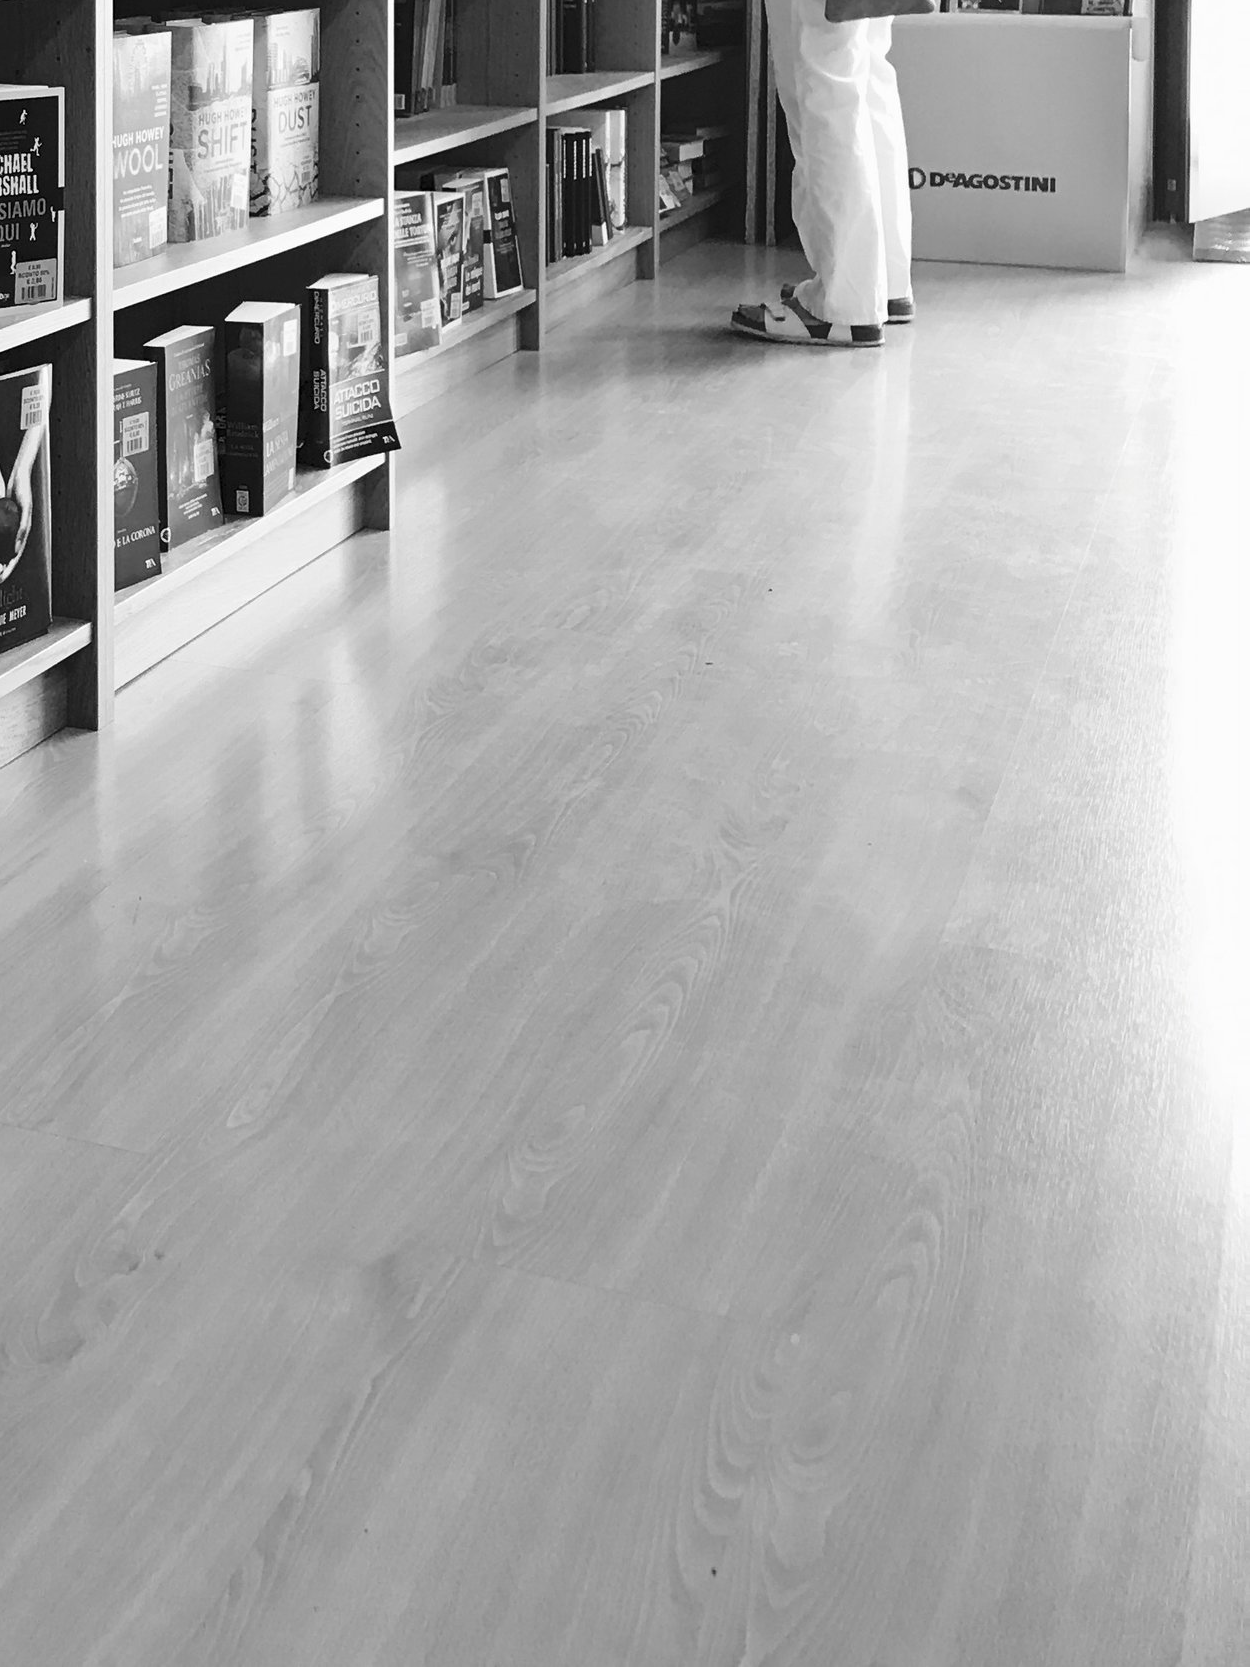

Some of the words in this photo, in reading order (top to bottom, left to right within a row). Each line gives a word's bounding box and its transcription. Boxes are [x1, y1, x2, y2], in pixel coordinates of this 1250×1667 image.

[278, 105, 312, 133] DUST
[111, 132, 134, 148] HUGH
[136, 126, 165, 143] HOWEY
[198, 121, 247, 159] SHIFT
[112, 144, 163, 179] WOOL
[169, 358, 211, 392] GREANIAS
[333, 379, 380, 405] ATTACCO
[335, 395, 381, 421] SUICIDA
[122, 534, 131, 545] LA
[130, 526, 156, 542] CORONA
[9, 605, 26, 622] MEYER
